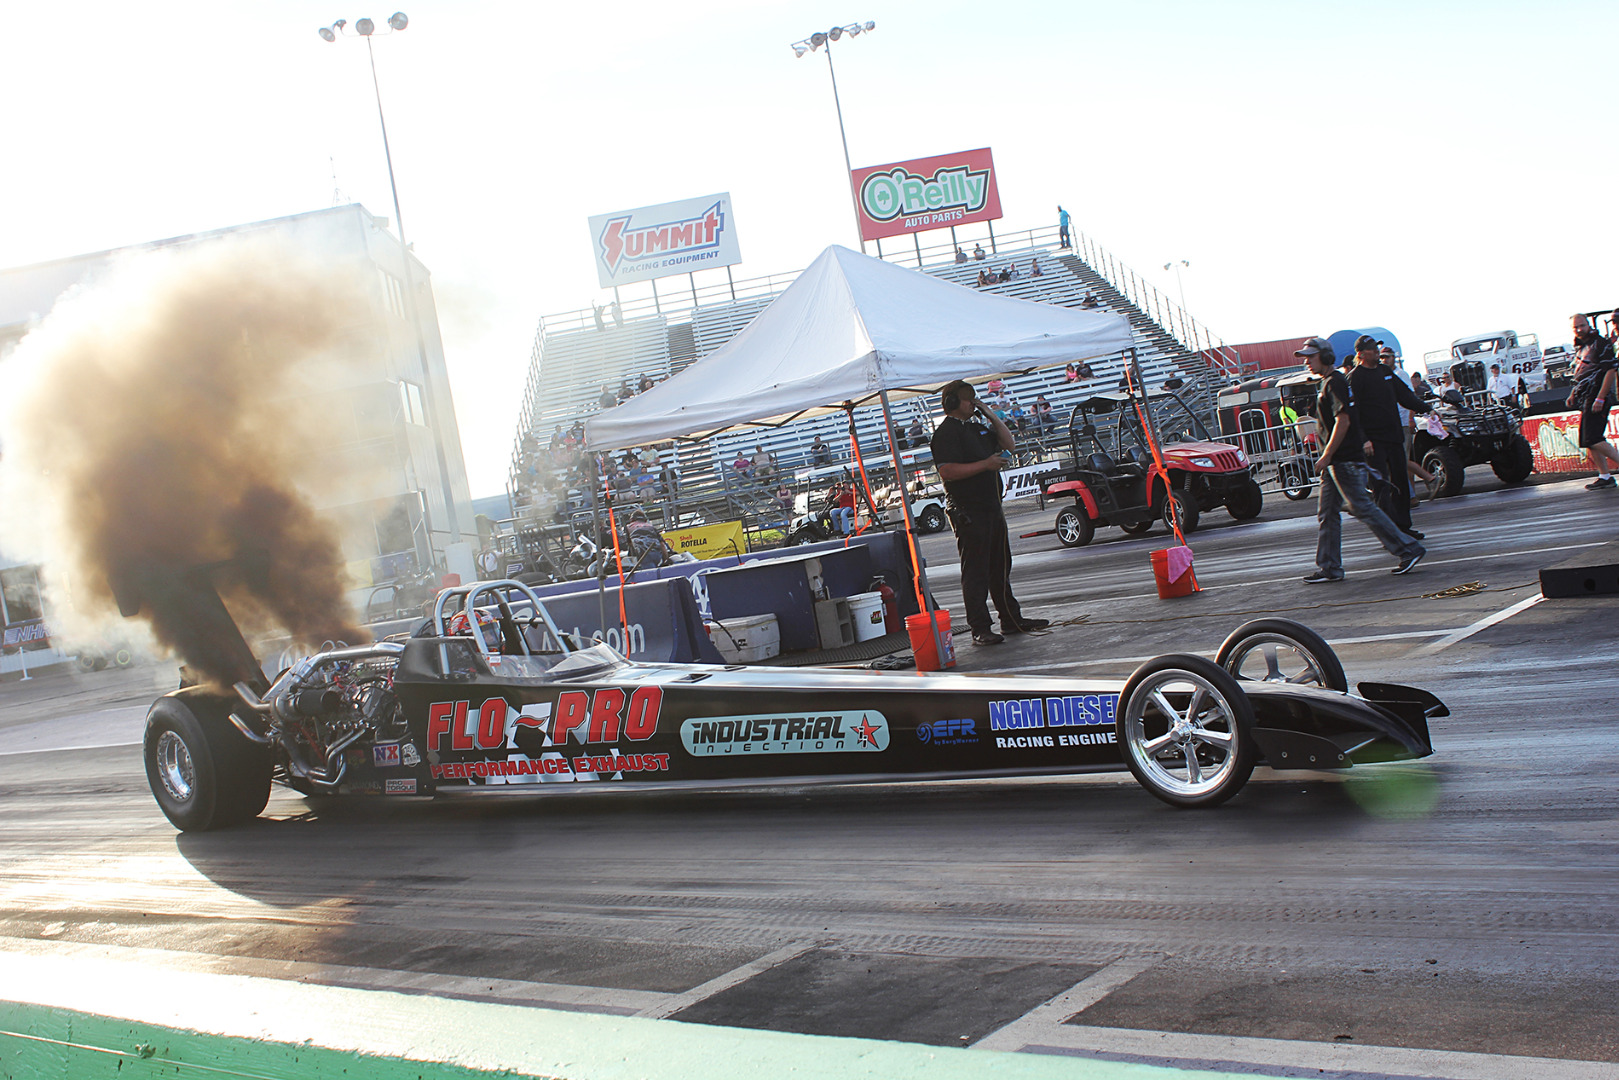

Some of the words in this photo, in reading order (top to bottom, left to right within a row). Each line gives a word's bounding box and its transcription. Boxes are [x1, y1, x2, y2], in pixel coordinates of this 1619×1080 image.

[866, 170, 985, 217] O'Reilly
[904, 215, 930, 228] AUTO
[932, 210, 963, 223] PARTS
[622, 260, 659, 274] RACING
[662, 250, 720, 267] EQUIPMENT
[1512, 361, 1533, 374] 68
[680, 538, 708, 548] ROTELLA
[427, 696, 509, 751] FLO
[552, 685, 664, 745] PRO
[988, 698, 1045, 731] NGM
[932, 718, 977, 737] EFR
[693, 741, 845, 754] INJECTION
[996, 736, 1054, 749] RACING
[1059, 732, 1118, 747] ENGINE
[374, 745, 398, 760] NX
[429, 757, 571, 779] PERFORMANCE
[572, 753, 670, 774] EXHAUST
